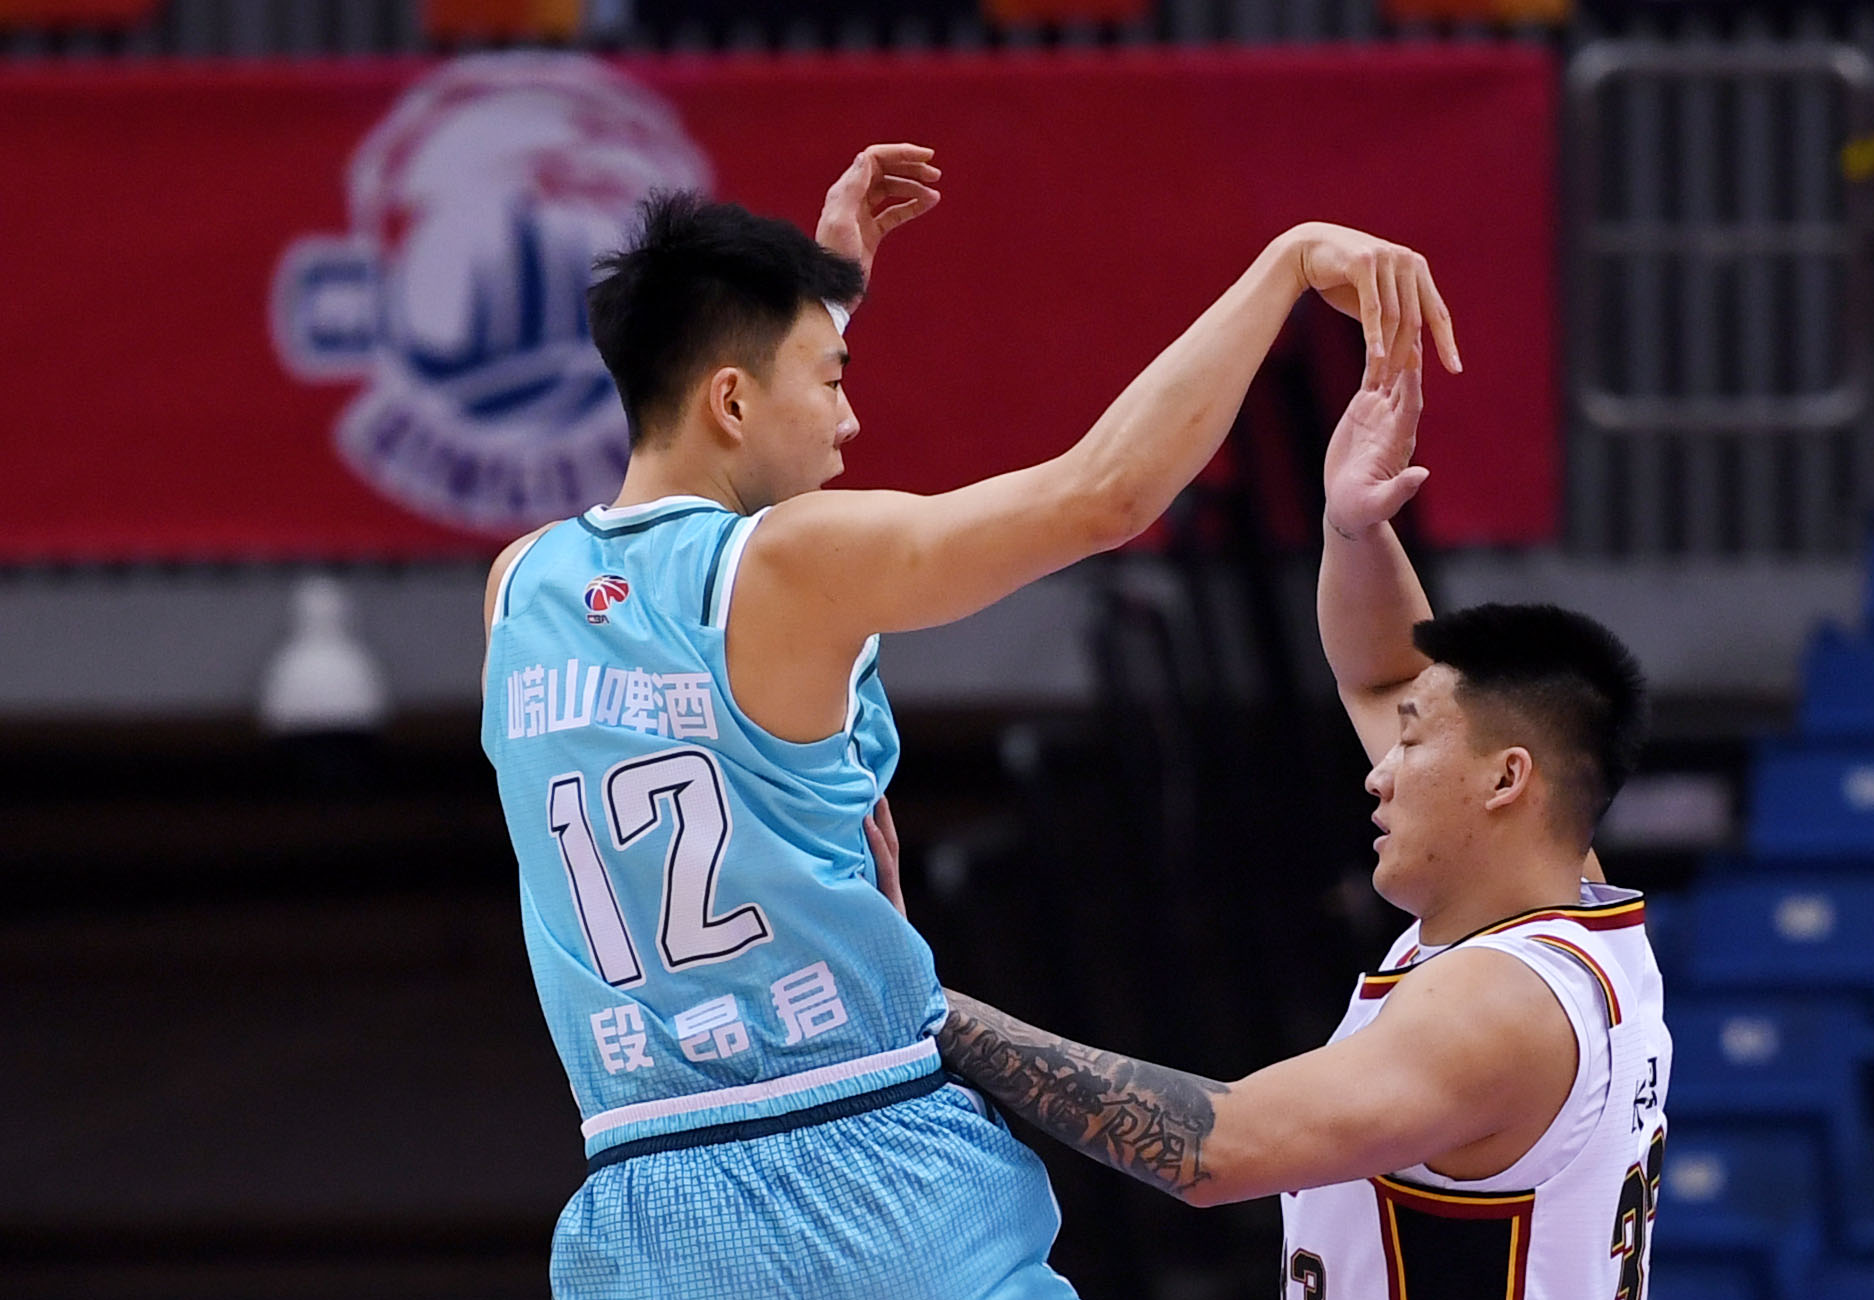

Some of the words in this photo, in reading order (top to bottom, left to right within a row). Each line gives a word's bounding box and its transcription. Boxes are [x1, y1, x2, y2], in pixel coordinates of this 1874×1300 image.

[507, 658, 719, 740] 崂山啤酒
[548, 747, 774, 989] 12
[590, 960, 848, 1075] 段昂君
